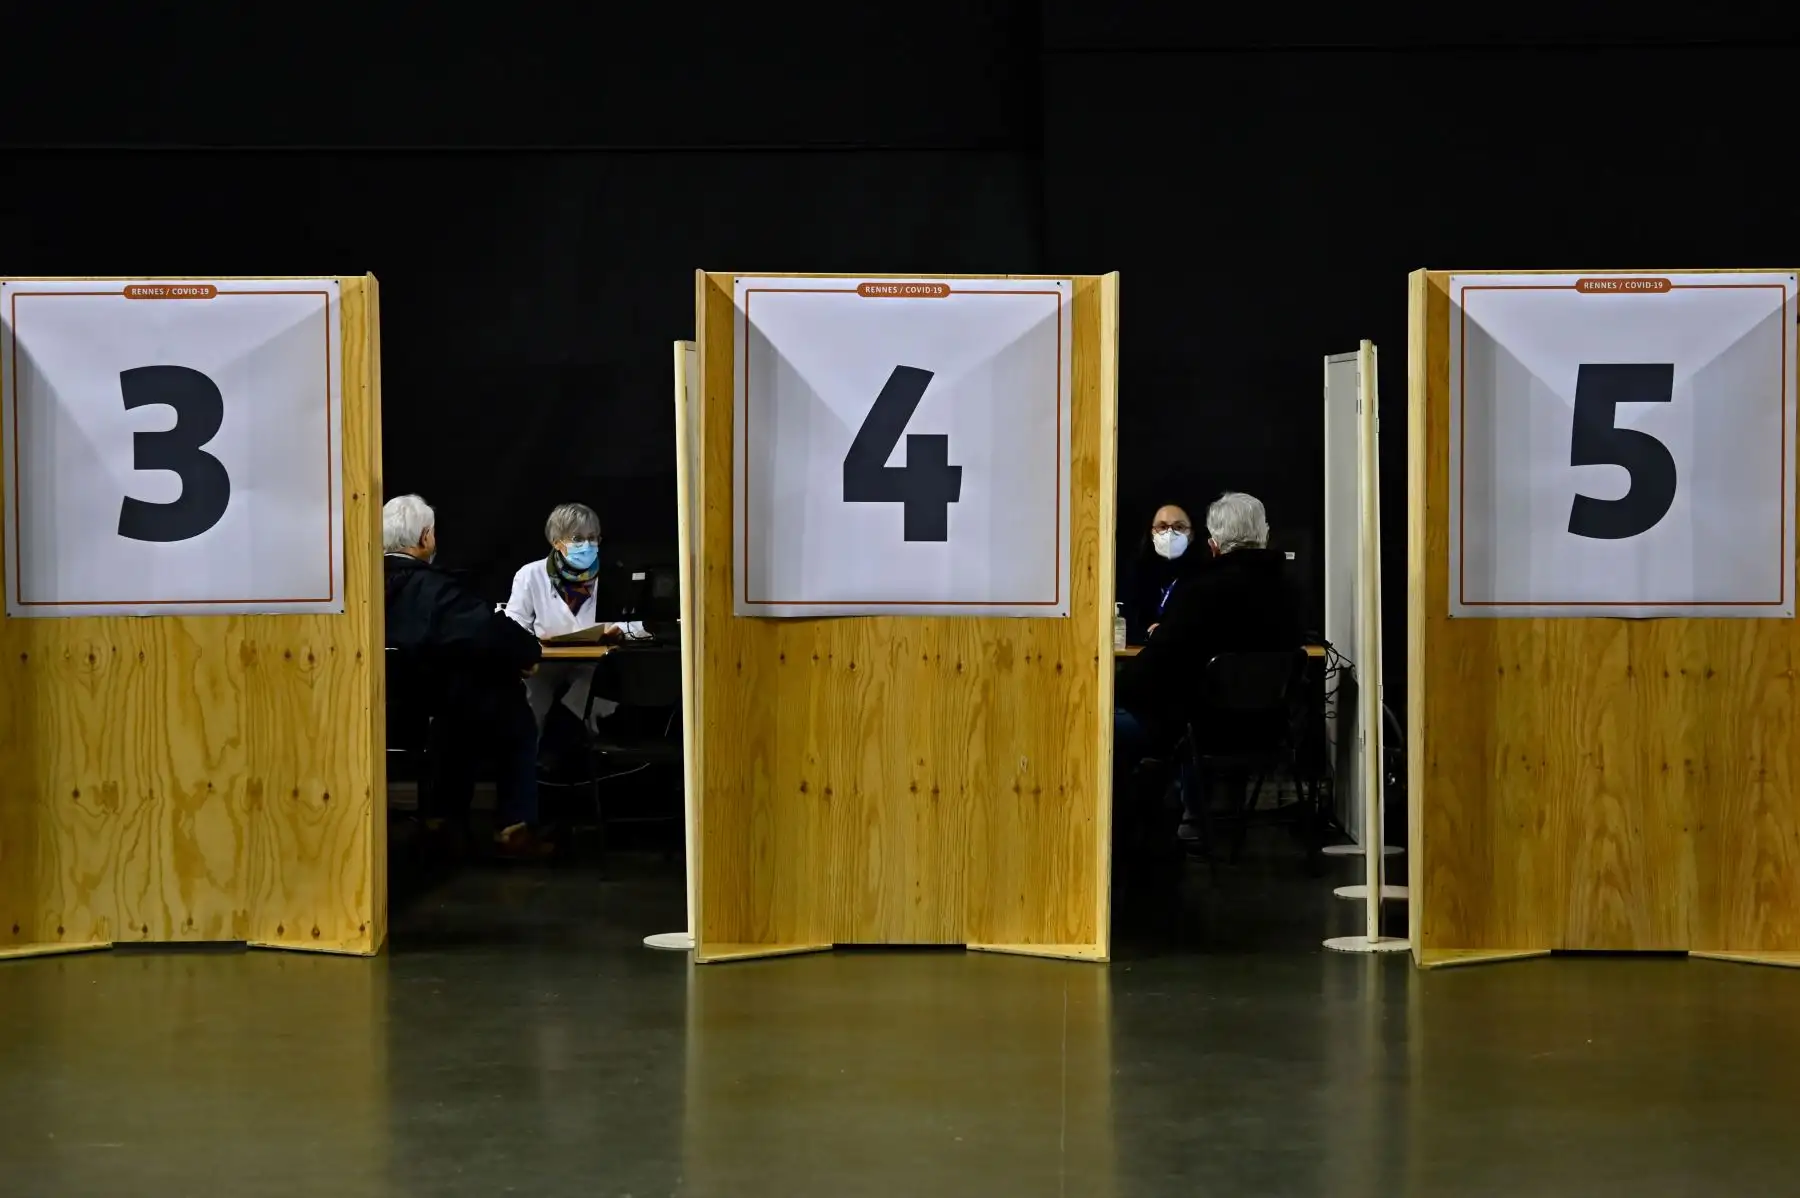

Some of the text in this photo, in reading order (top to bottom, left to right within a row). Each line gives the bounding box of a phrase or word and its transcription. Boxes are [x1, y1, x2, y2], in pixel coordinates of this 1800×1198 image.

[905, 286, 942, 294] COVID-19
[1584, 281, 1617, 289] RENNES
[1625, 281, 1663, 289] COVID-19
[118, 366, 231, 542] 3
[843, 365, 962, 541] 4
[1568, 363, 1677, 539] 5
